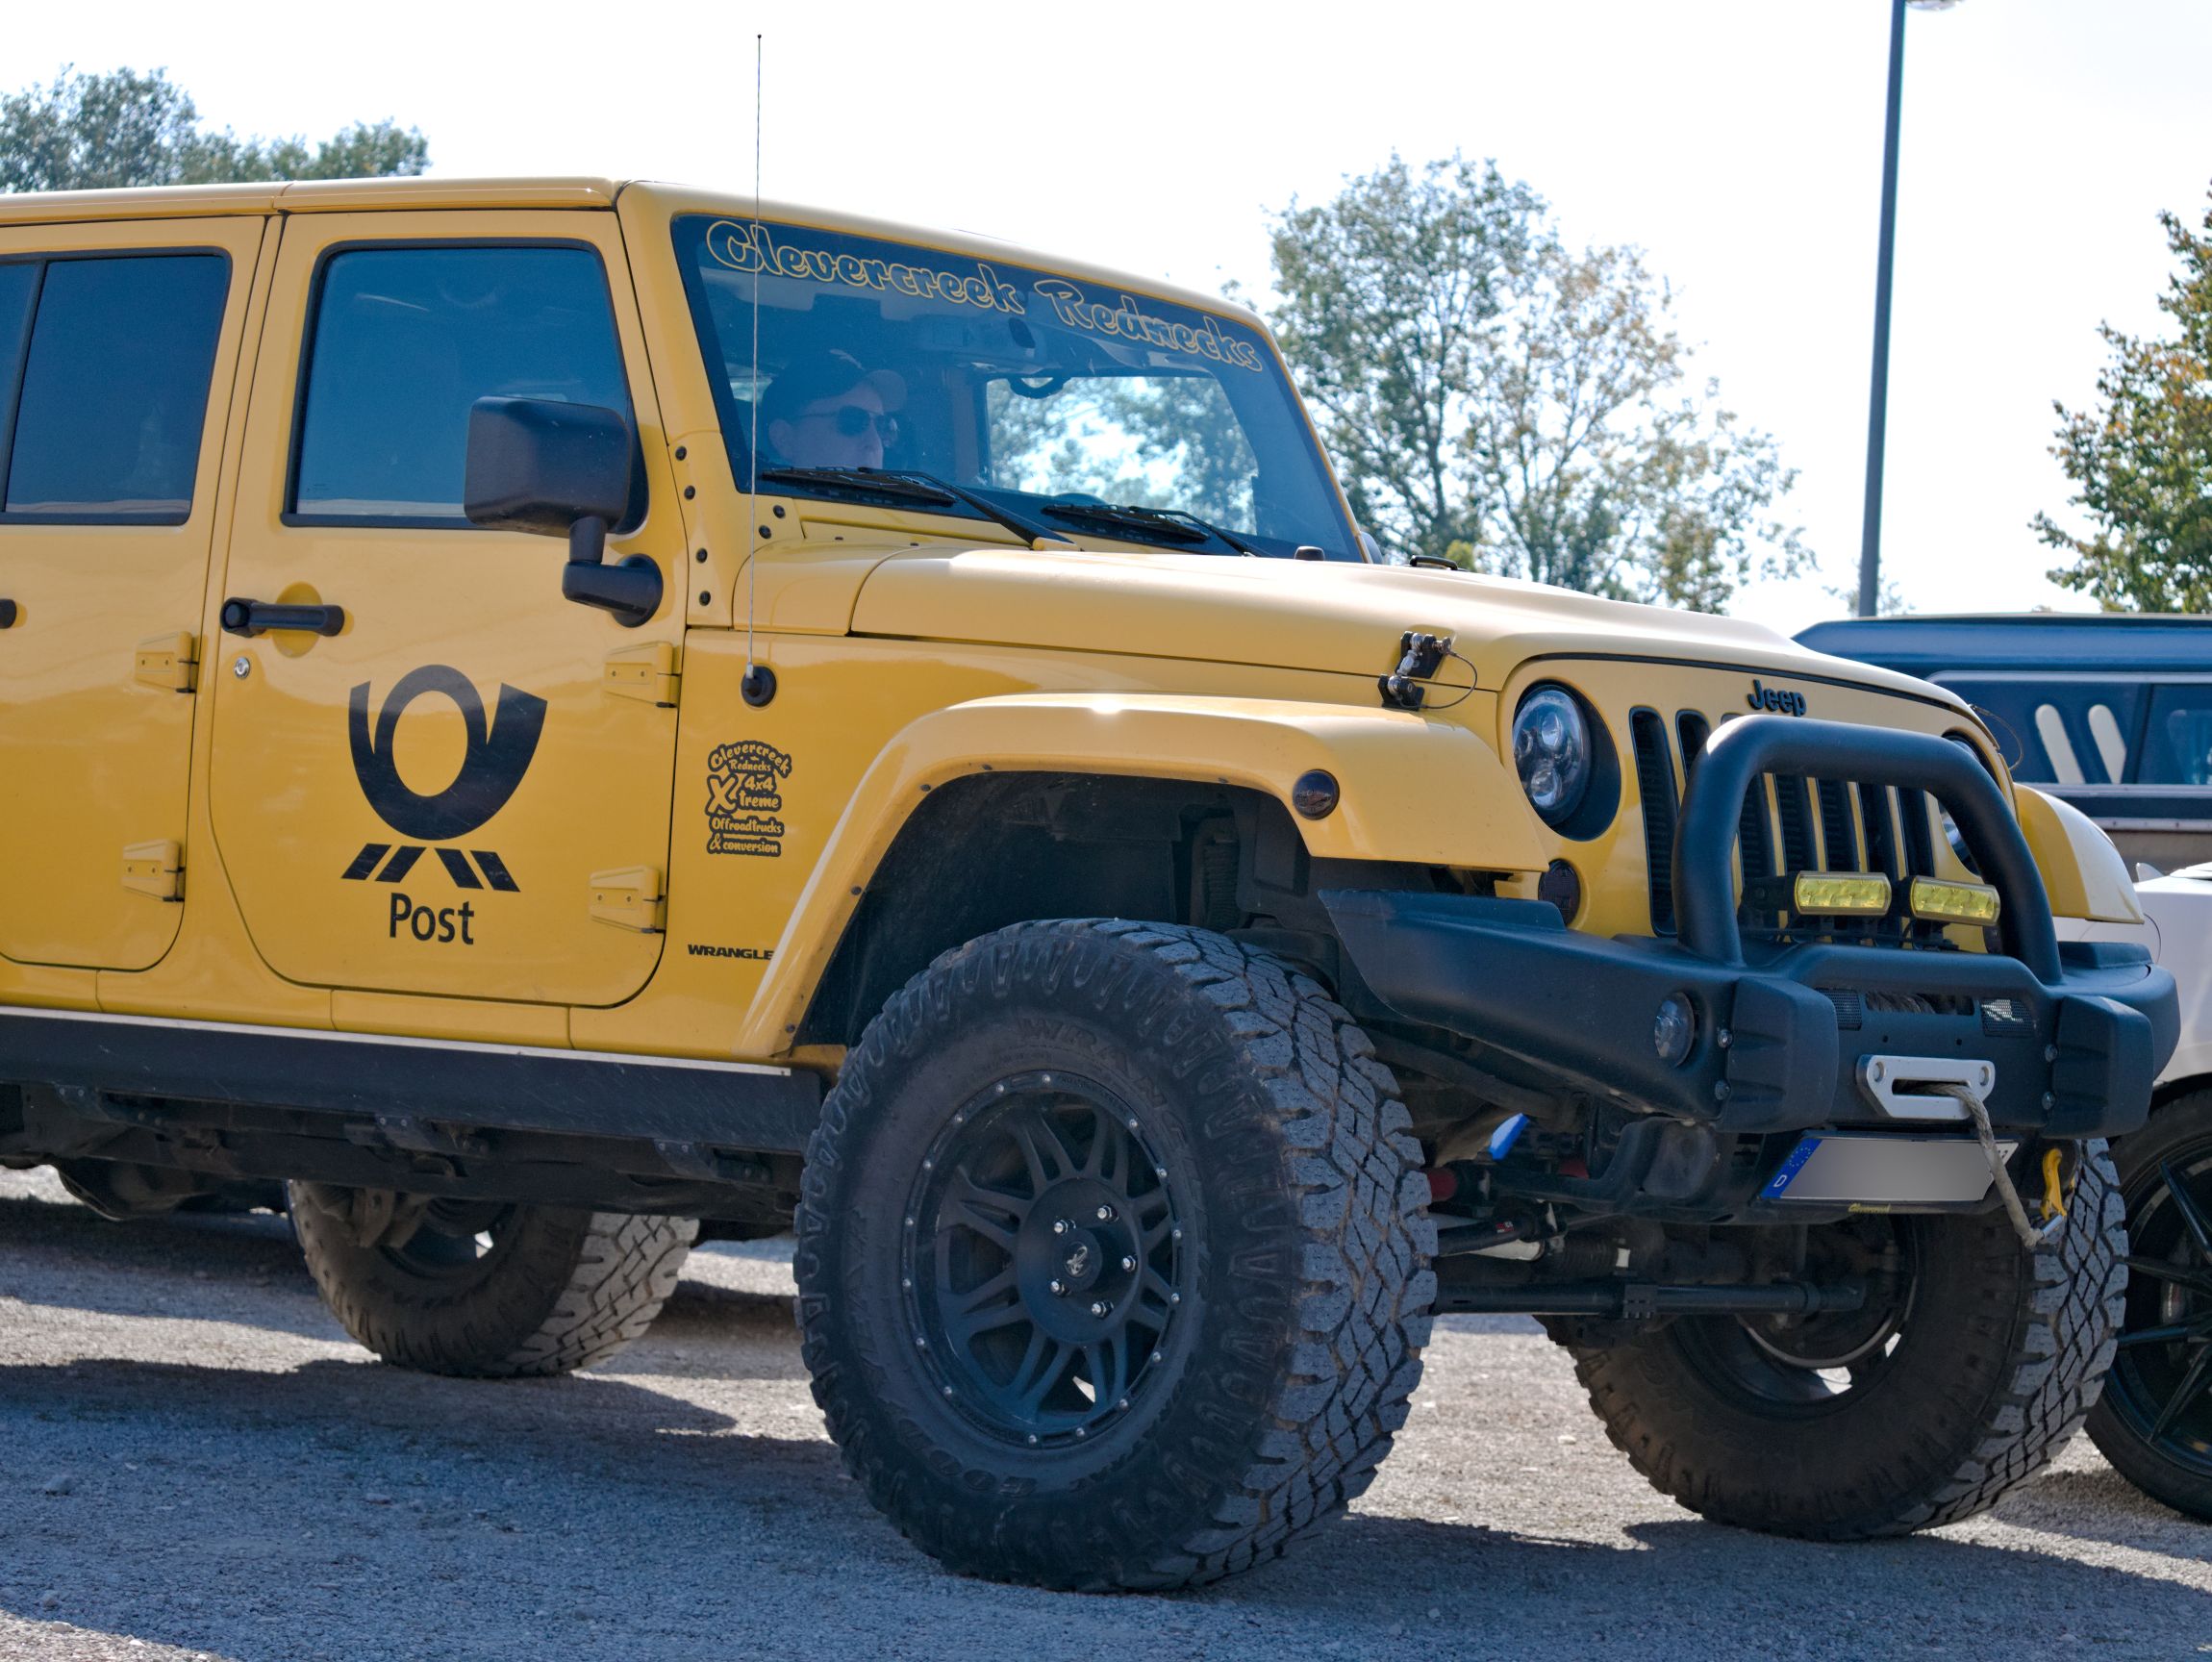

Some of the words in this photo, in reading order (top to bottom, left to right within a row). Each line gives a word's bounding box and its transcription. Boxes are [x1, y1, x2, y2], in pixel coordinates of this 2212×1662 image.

[707, 220, 1025, 315] Clevercreek
[1034, 278, 1264, 372] Rednecks
[1747, 679, 1806, 718] Jeep
[710, 743, 790, 776] Clevercreek
[729, 759, 771, 771] Rednecks
[744, 775, 773, 791] 4x4
[712, 817, 782, 834] Offroadtrucks
[710, 833, 721, 851] &
[722, 840, 779, 854] conversion
[390, 893, 475, 944] Post
[688, 944, 774, 960] WRANGLE
[1773, 1174, 1788, 1188] D
